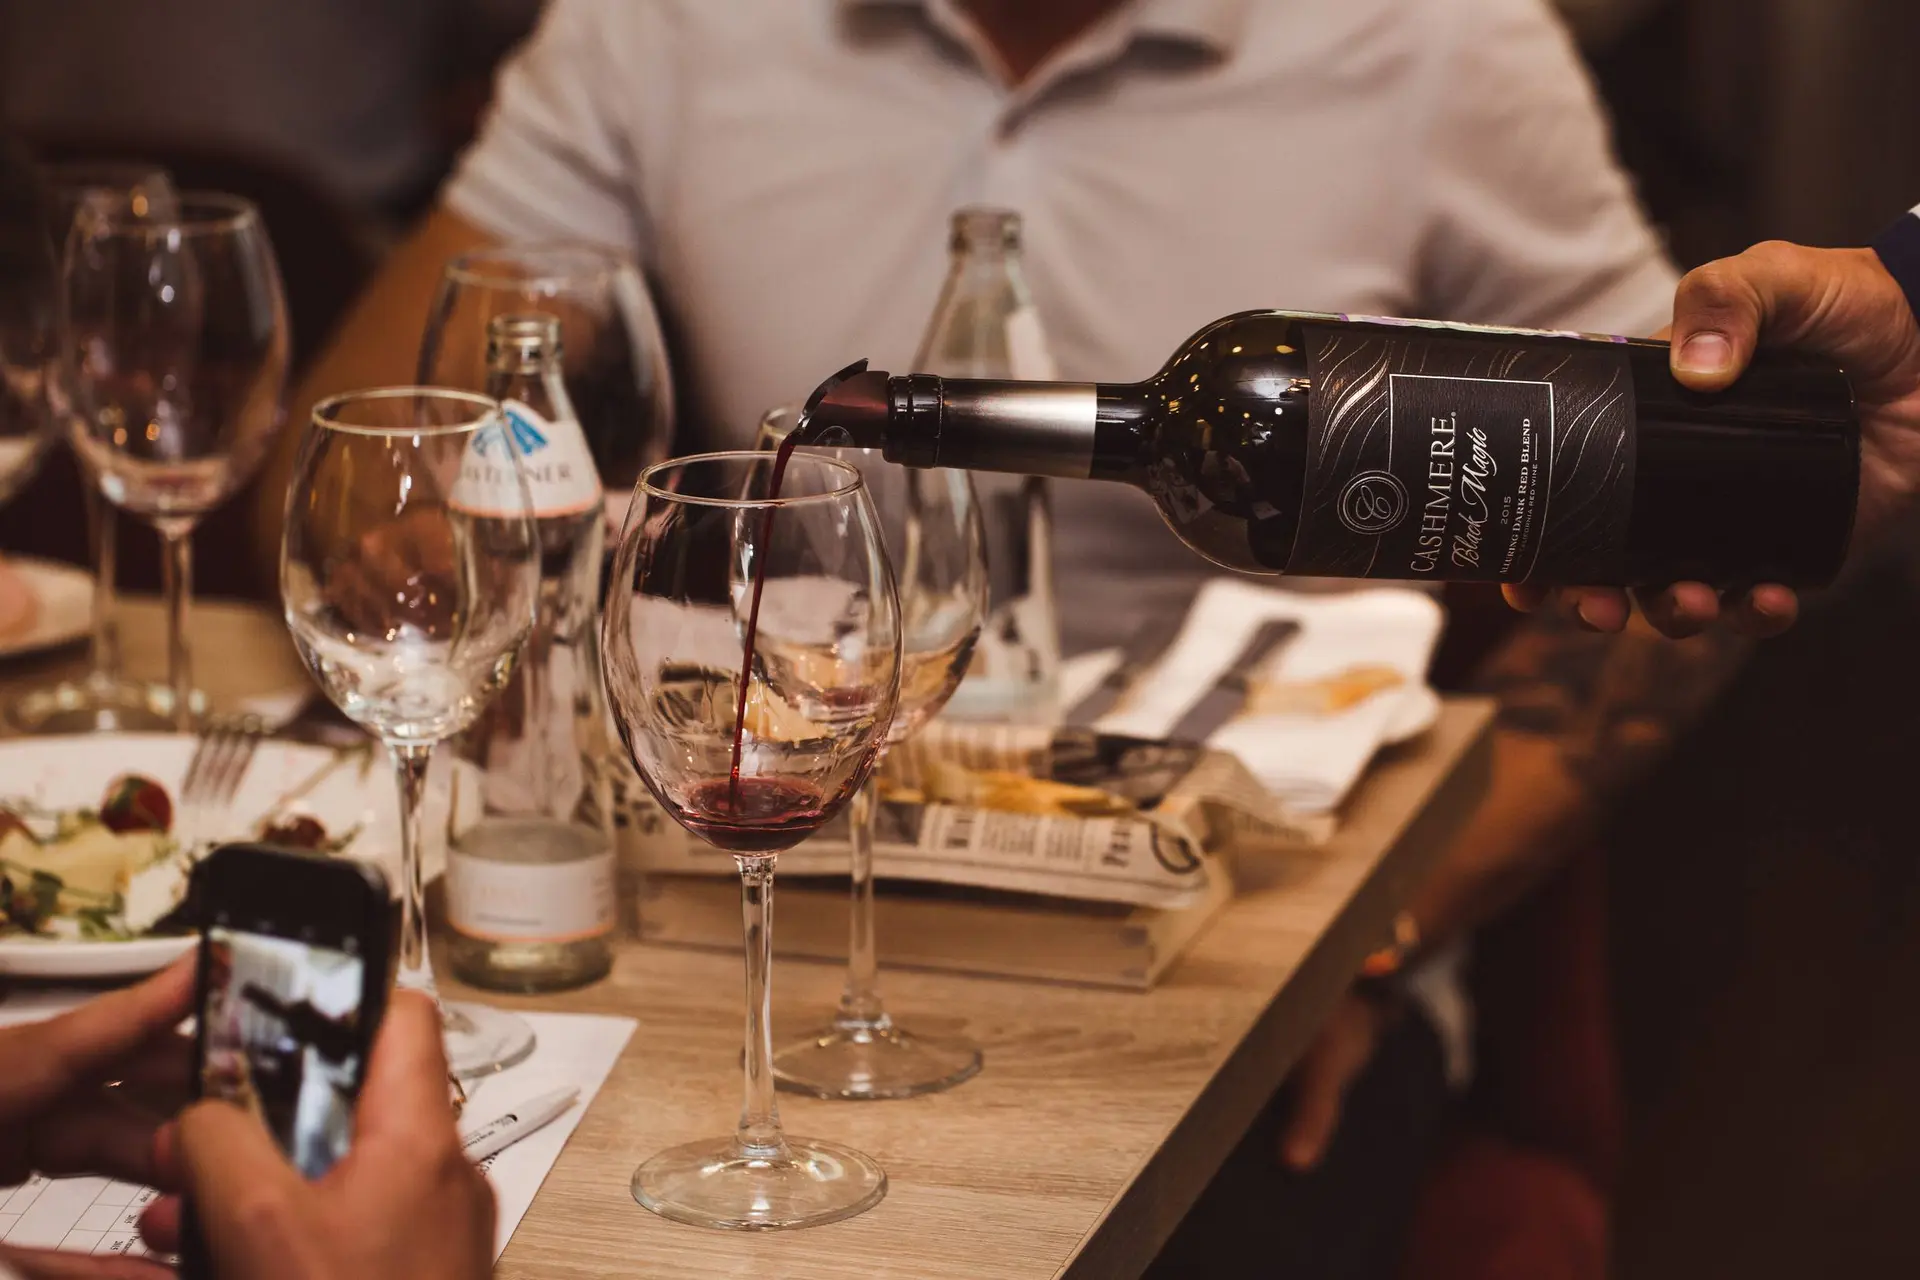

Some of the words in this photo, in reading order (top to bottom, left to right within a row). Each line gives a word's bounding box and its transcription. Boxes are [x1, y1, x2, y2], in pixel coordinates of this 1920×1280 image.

[1521, 418, 1530, 463] BLEND
[1461, 427, 1497, 519] Magic
[1518, 466, 1528, 494] RED
[1501, 496, 1511, 524] 2015
[1513, 498, 1525, 530] DARK
[1452, 512, 1487, 567] Black
[1499, 534, 1518, 573] ALLURING
